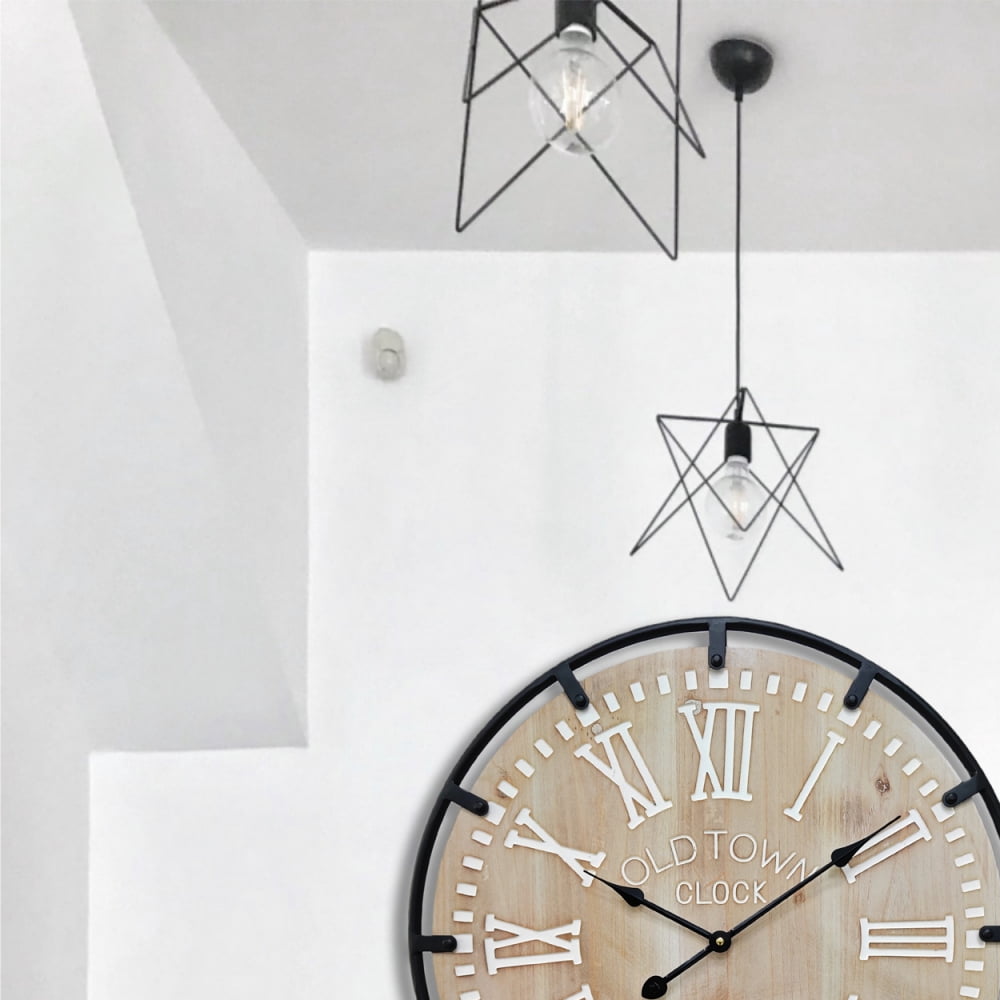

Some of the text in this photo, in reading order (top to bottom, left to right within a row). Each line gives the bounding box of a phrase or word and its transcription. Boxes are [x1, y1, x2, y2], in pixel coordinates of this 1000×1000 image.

[574, 721, 674, 830] XI
[678, 702, 760, 802] XII
[784, 730, 847, 822] I
[504, 807, 607, 888] X
[621, 830, 819, 886] OLD TOWN
[843, 808, 932, 885] II
[675, 881, 767, 905] CLOCK
[484, 913, 583, 976] IX
[859, 915, 955, 963] III
